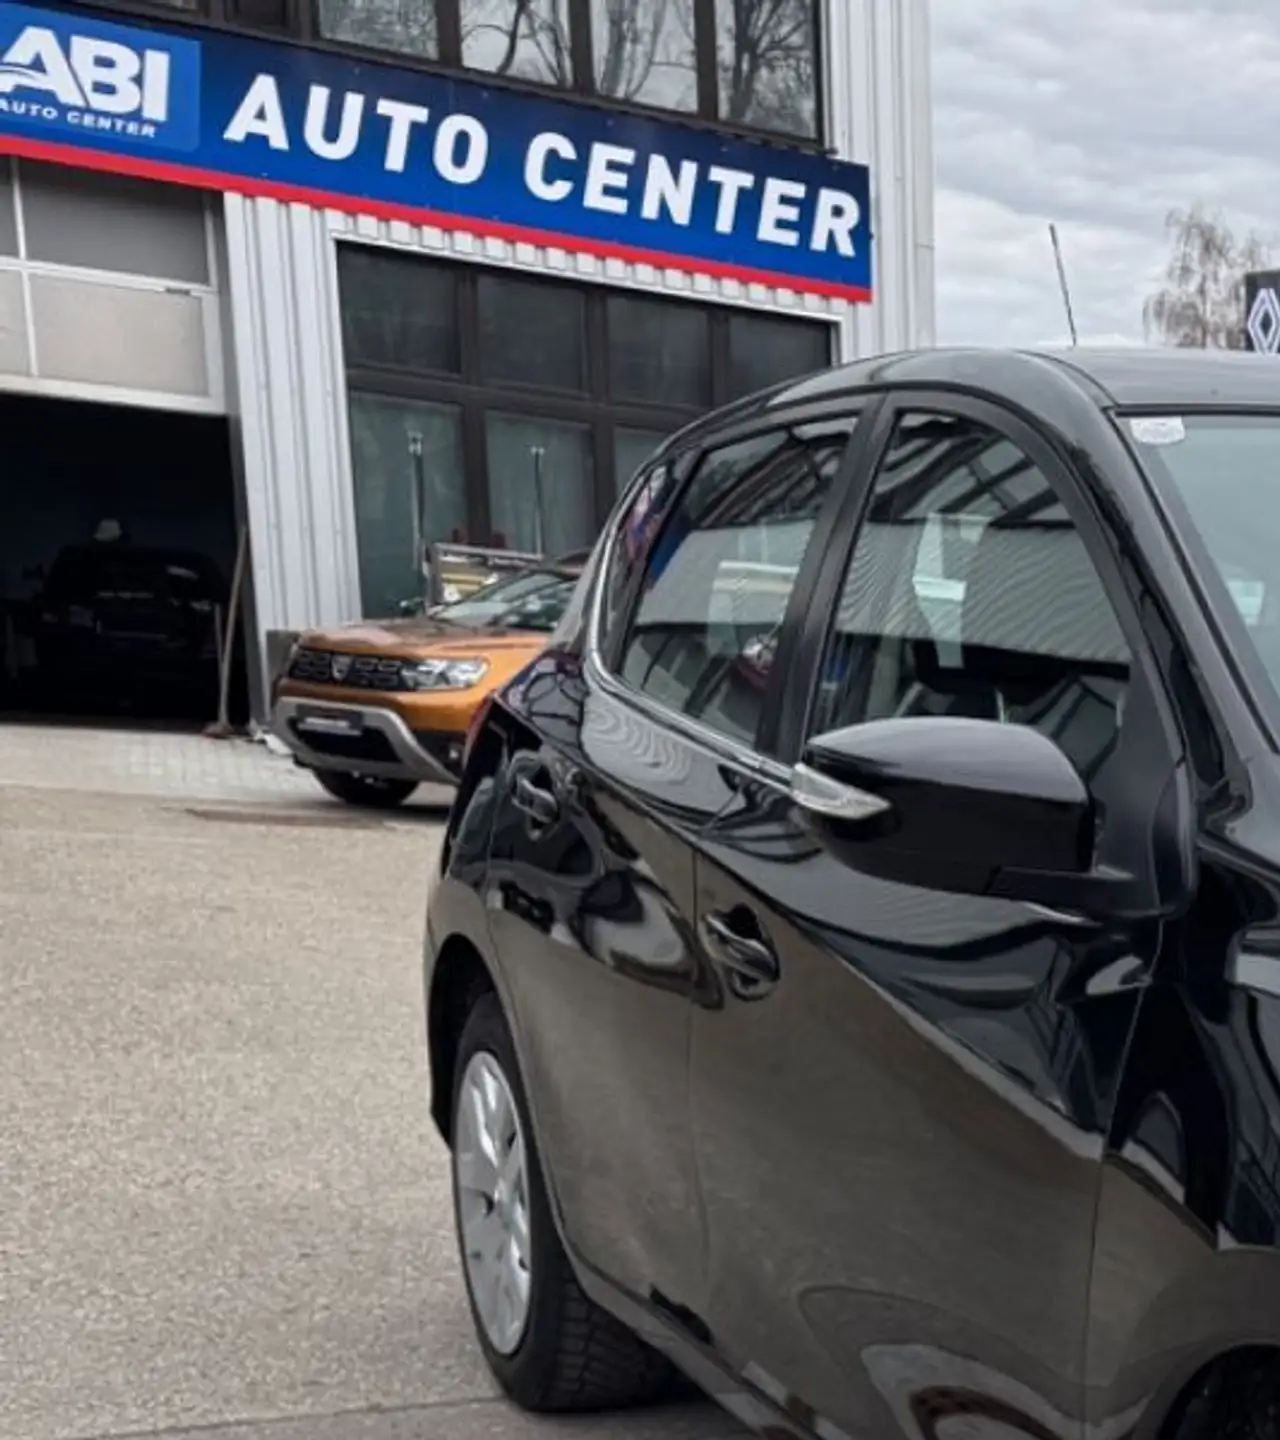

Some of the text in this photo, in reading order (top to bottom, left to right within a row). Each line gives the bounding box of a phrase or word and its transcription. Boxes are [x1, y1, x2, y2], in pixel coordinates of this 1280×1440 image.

[0, 26, 170, 122] ABI
[66, 110, 156, 138] CENTER
[223, 73, 861, 257] AUTO CENTER
